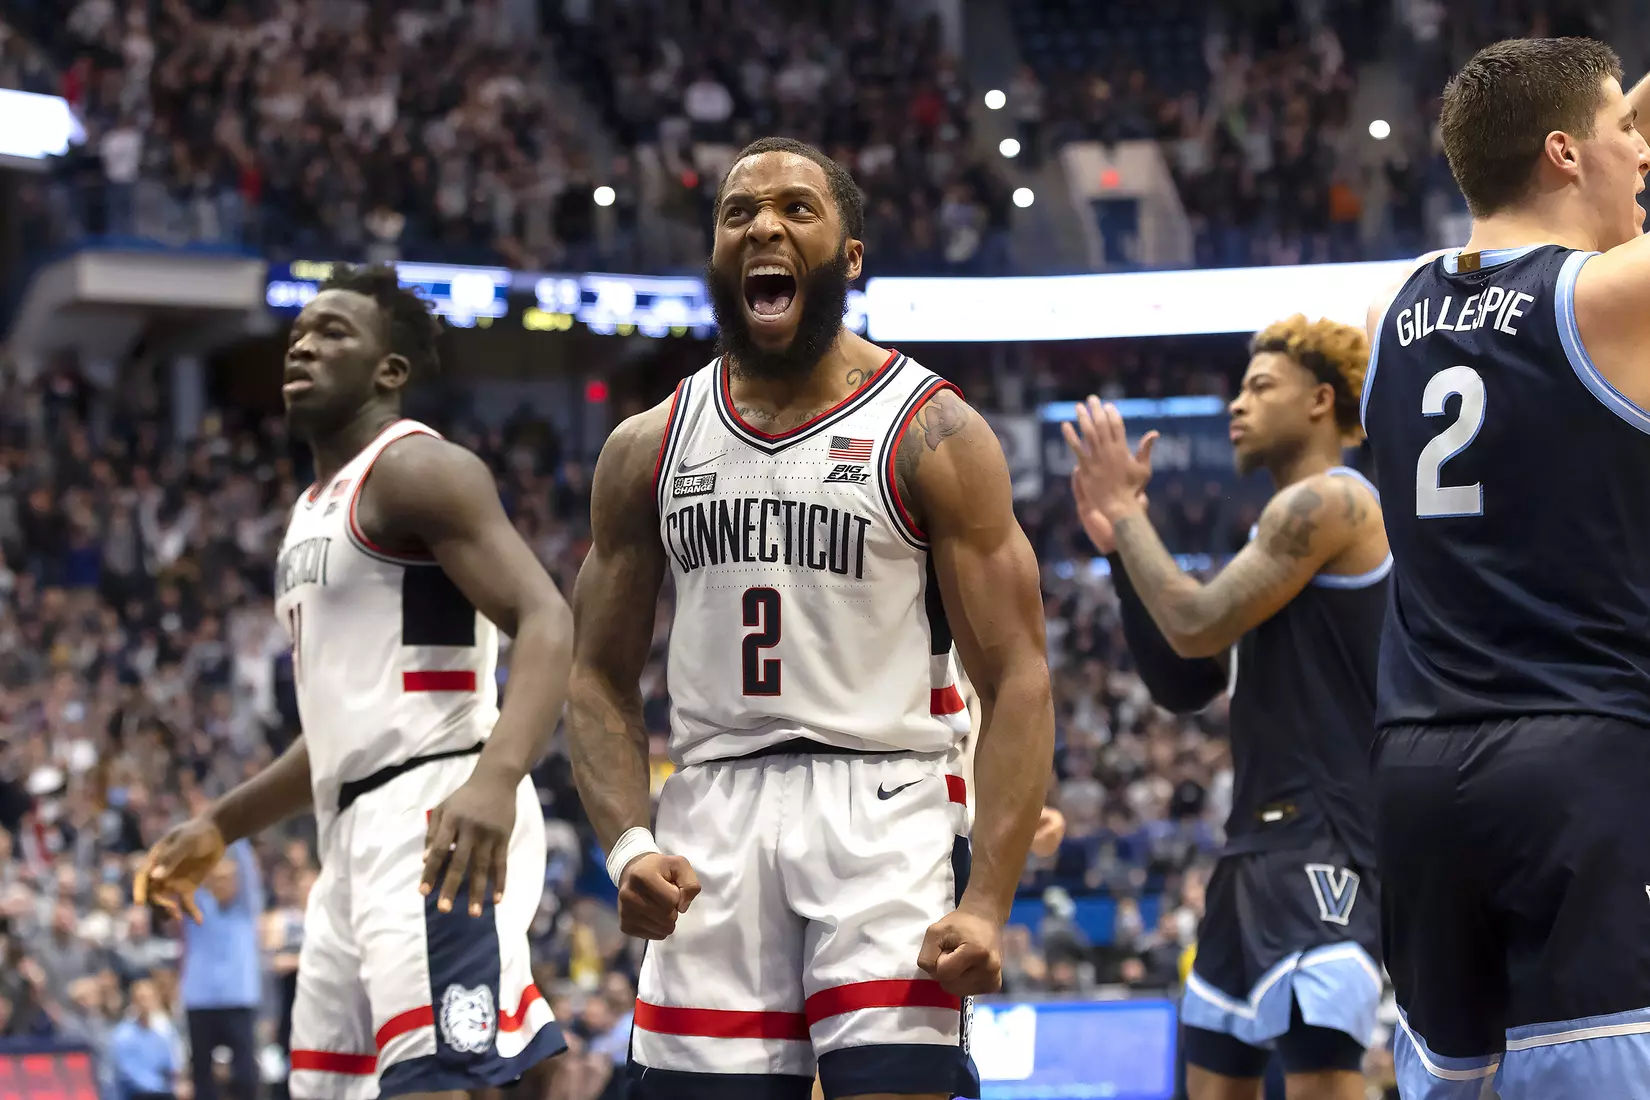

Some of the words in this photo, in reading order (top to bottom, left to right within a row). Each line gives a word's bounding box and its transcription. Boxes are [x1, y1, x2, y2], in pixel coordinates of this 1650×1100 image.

[1396, 286, 1534, 347] GILLESPIE
[832, 464, 865, 474] BIG
[1416, 365, 1487, 519] 2
[674, 484, 714, 495] CHANGE
[826, 472, 871, 482] EAST
[666, 498, 871, 579] CONNECTICUT
[742, 586, 781, 696] 2
[1304, 862, 1361, 926] V
